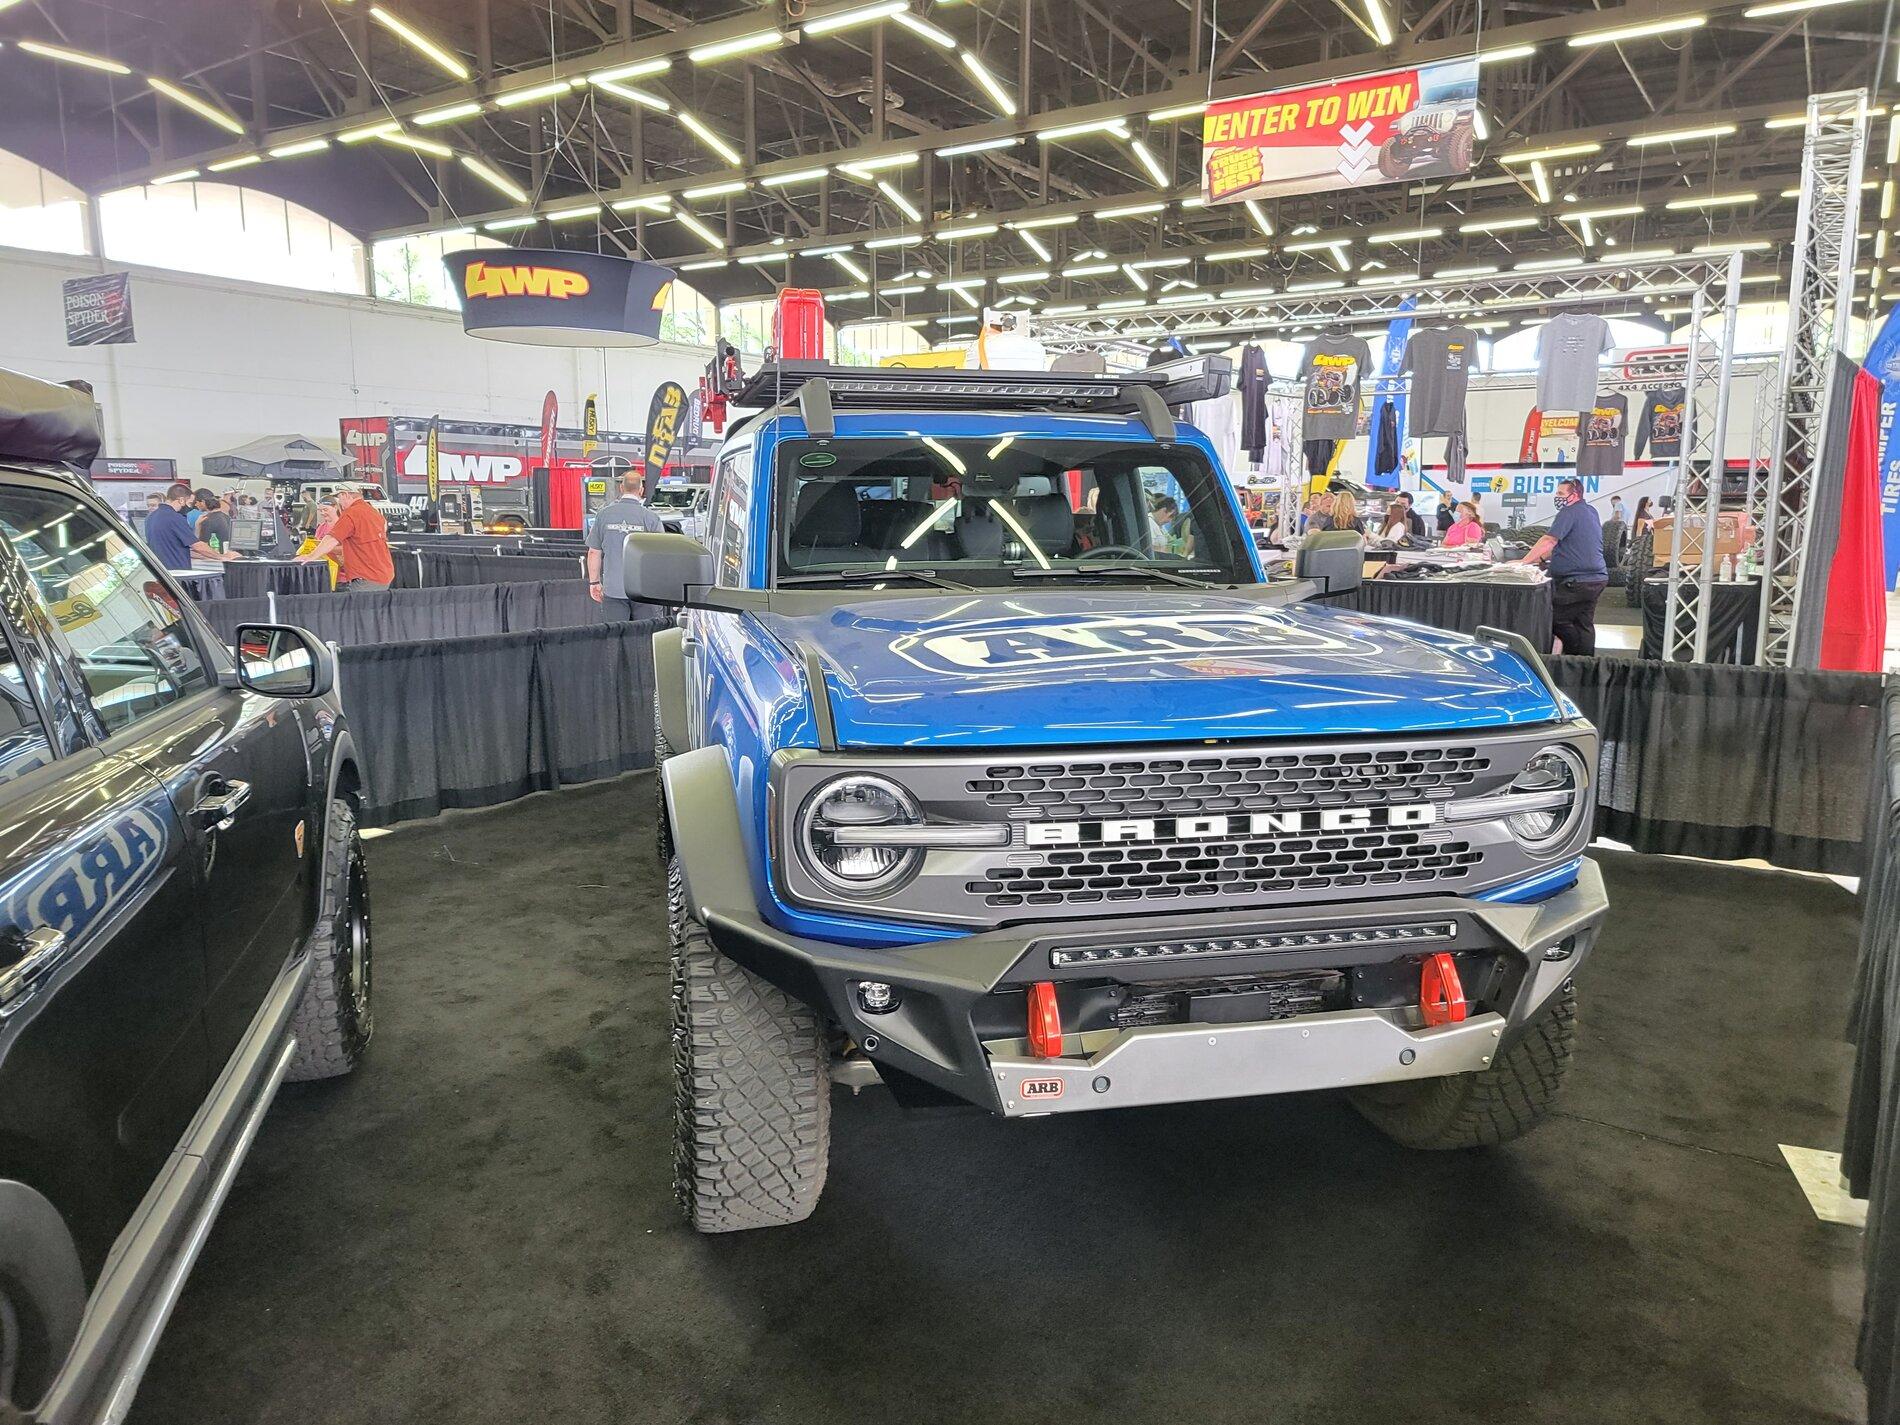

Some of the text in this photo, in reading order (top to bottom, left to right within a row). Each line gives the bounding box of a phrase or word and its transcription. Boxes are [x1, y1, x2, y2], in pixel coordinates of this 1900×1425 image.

[1305, 96, 1341, 129] TO
[1346, 83, 1413, 122] WIN
[1212, 166, 1263, 196] FEST
[466, 261, 591, 299] 4WP
[65, 292, 106, 310] POISON
[66, 309, 110, 326] SPYDER
[346, 429, 387, 447] 4WP
[404, 444, 522, 482] 4WP
[1881, 459, 1900, 514] TIRES
[1025, 804, 1436, 845] BRONCO
[1027, 1082, 1059, 1094] ARB
